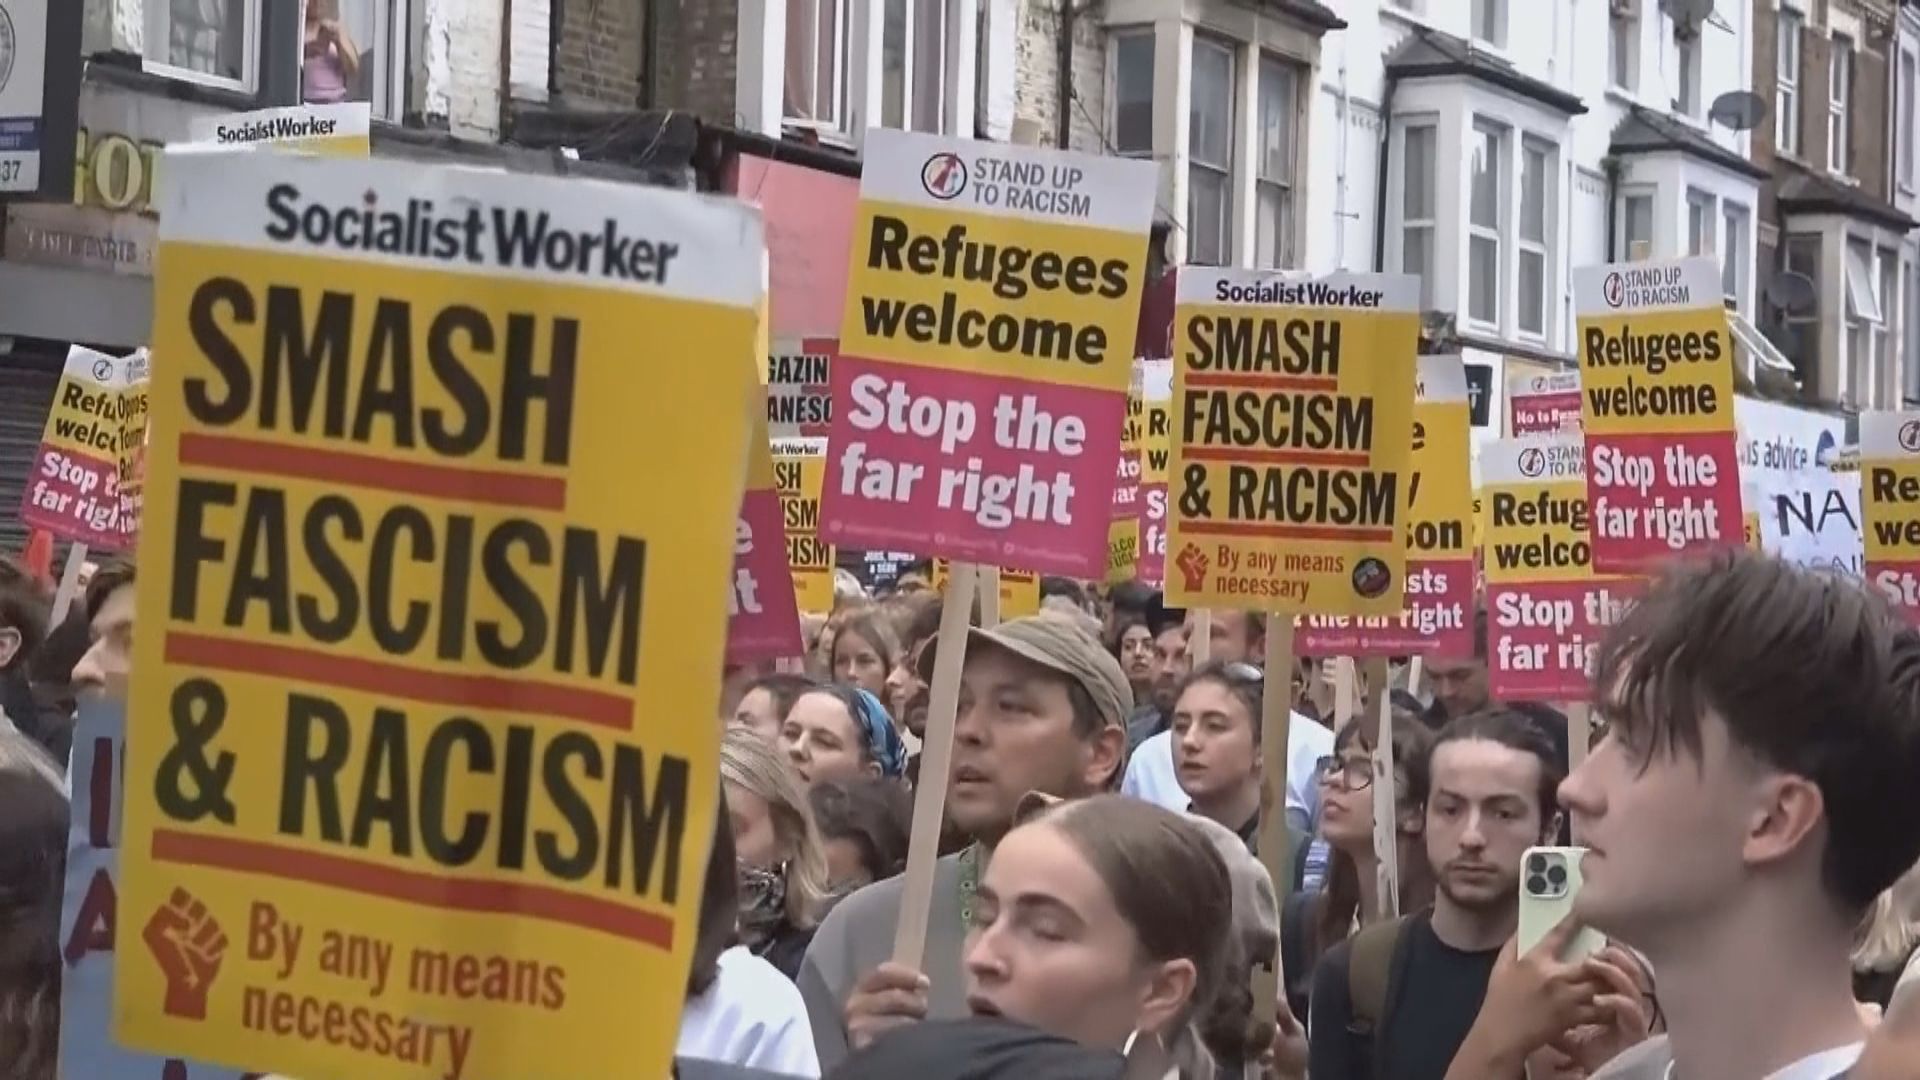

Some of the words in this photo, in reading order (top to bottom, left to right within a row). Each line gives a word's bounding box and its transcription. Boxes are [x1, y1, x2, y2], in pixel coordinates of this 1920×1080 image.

[276, 116, 336, 139] Worker
[973, 158, 1045, 185] STAND
[1052, 166, 1082, 189] UP
[973, 182, 1000, 205] TO
[1005, 187, 1091, 217] RACISM
[265, 183, 484, 263] Socialist
[492, 207, 679, 284] Worker
[867, 215, 1129, 299] Refugees
[1625, 268, 1662, 289] STAND
[1664, 267, 1682, 286] UP
[1215, 279, 1305, 305] Socialist
[1307, 284, 1384, 308] Worker
[1625, 290, 1639, 307] TO
[1642, 286, 1690, 306] RACISM
[861, 291, 1108, 364] welcome
[1184, 315, 1341, 375] SMASH
[1585, 325, 1722, 375] Refugees
[183, 276, 580, 466] SMASH
[847, 373, 977, 454] Stop
[993, 393, 1086, 457] the
[1589, 375, 1718, 417] welcome
[1183, 389, 1374, 451] FASCISM
[42, 451, 98, 491] Stop
[772, 462, 801, 489] SH
[1549, 461, 1565, 476] TO
[1592, 444, 1655, 497] Stop
[1663, 445, 1718, 488] the
[1763, 435, 1808, 471] advice
[33, 481, 71, 513] far
[840, 442, 925, 503] far
[937, 457, 1075, 528] right
[1177, 463, 1212, 518] &
[1228, 465, 1398, 526] RACISM
[1595, 496, 1638, 538] far
[1643, 496, 1720, 549] right
[170, 479, 647, 686] FASCISM
[1216, 545, 1243, 572] By
[1247, 550, 1277, 573] any
[1284, 552, 1345, 574] means
[1215, 574, 1311, 603] necessary
[1496, 592, 1574, 635] Stop
[1497, 635, 1549, 671] far
[153, 677, 236, 825] &
[279, 692, 691, 906] RACISM
[247, 901, 304, 979] By
[319, 928, 393, 998] any
[409, 945, 566, 1011] means
[241, 985, 472, 1080] necessary
